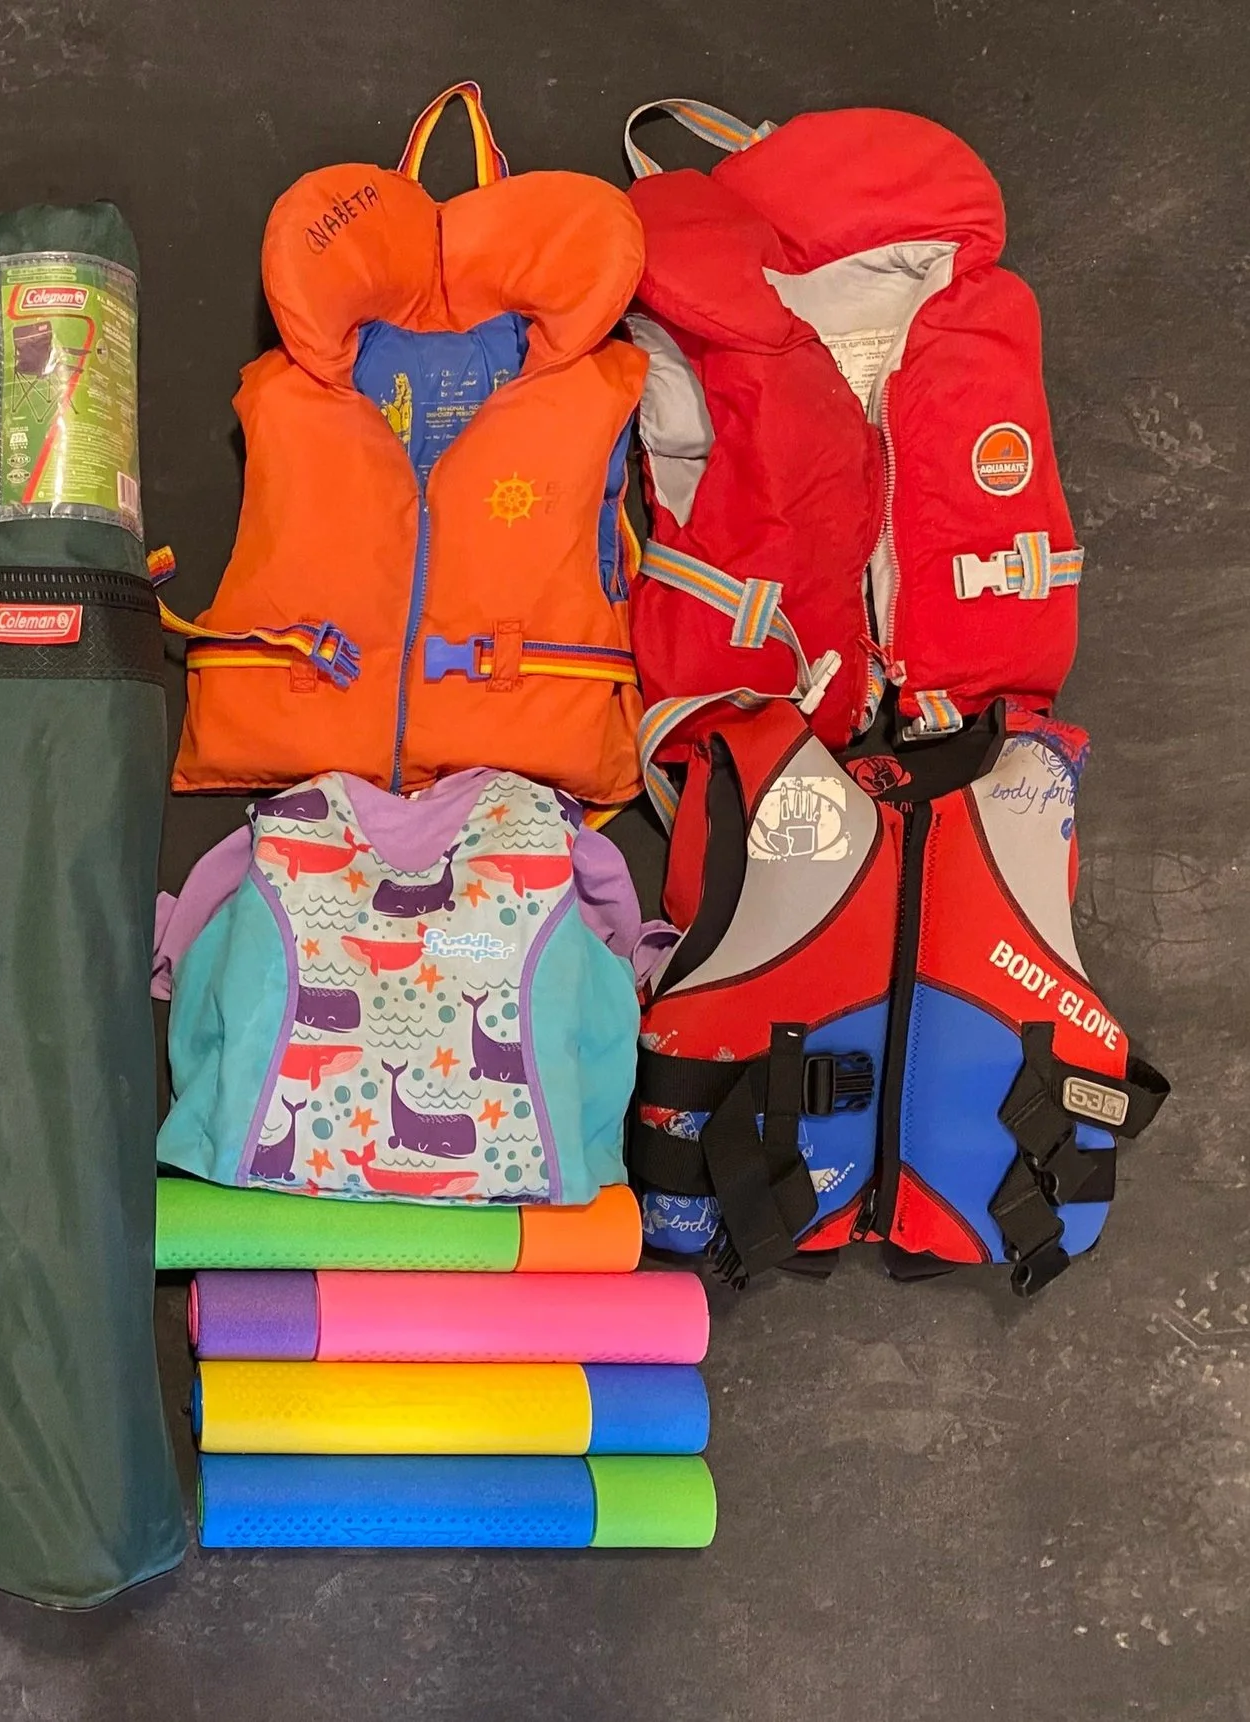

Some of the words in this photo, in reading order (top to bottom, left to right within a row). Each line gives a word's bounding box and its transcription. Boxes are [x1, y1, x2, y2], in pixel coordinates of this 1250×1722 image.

[25, 289, 75, 305] Coleman
[980, 464, 1025, 474] AQUAMATE
[424, 929, 503, 949] Puddle
[421, 942, 514, 962] Jumper
[989, 940, 1058, 1000] BODY
[1057, 991, 1121, 1051] GLOVE
